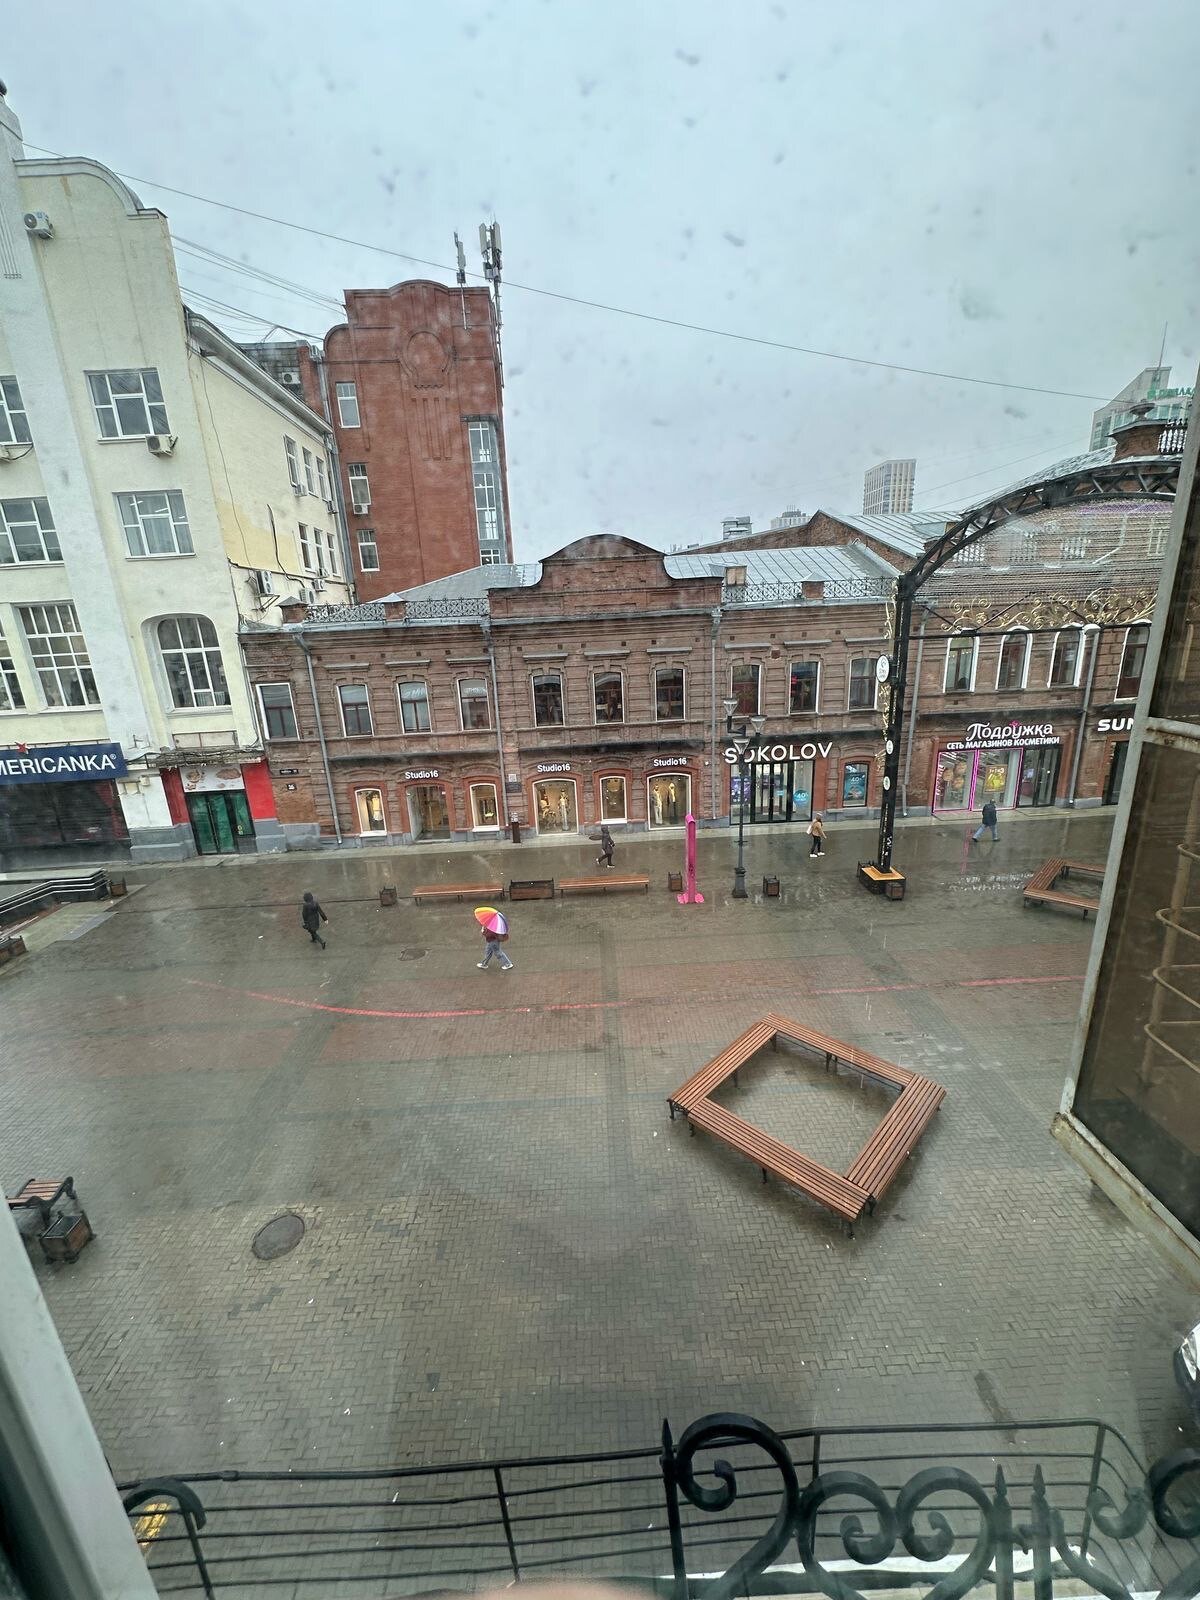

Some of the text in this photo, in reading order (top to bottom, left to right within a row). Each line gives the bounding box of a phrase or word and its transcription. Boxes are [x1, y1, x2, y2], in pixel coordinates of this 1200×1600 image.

[966, 722, 1053, 742] Подружка
[946, 736, 1060, 750] СЕТЬ МАГАЗИНОВ КОСМЕТИКИ
[653, 757, 687, 767] Studio16
[537, 763, 571, 773] Studio16
[405, 770, 439, 780] Studio16
